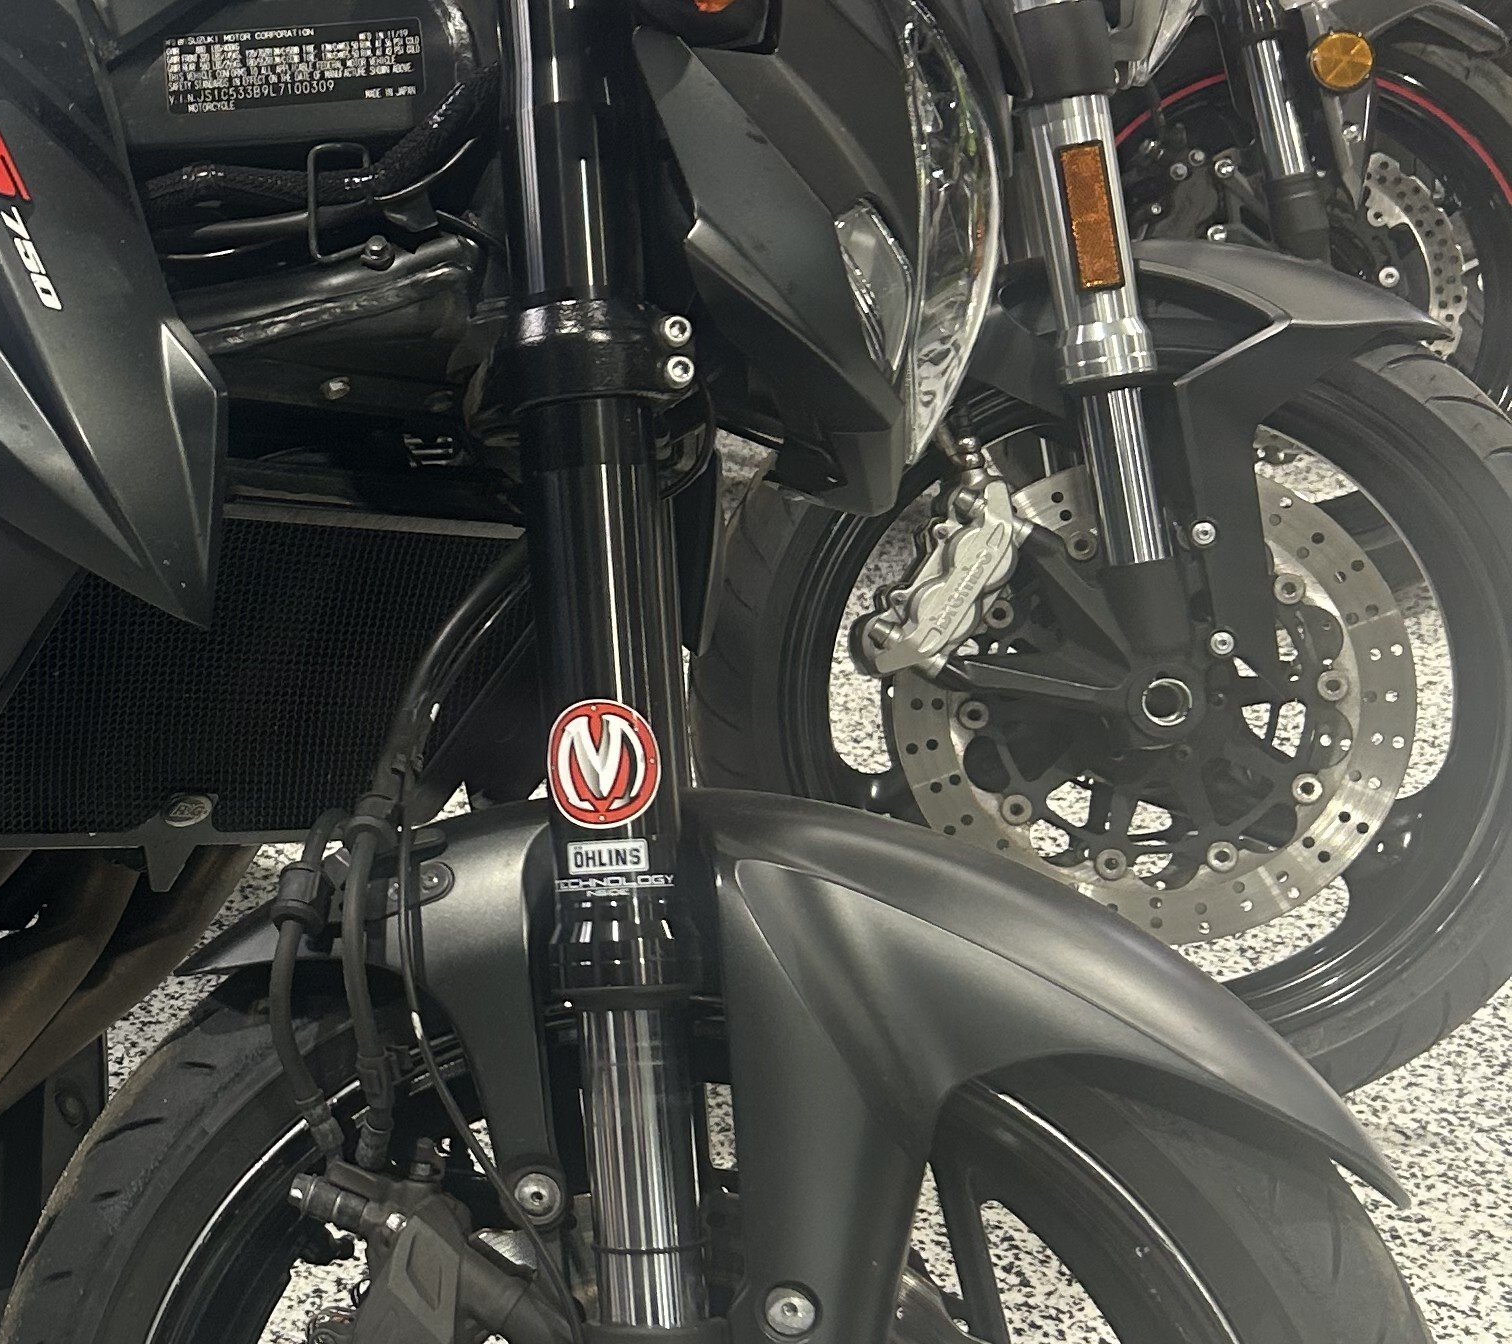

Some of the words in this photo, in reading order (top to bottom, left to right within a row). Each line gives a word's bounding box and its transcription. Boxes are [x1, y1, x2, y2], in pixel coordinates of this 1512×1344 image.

[188, 35, 219, 45] SUZUKI
[223, 32, 252, 43] MOTOR
[254, 28, 315, 41] CORPORATION
[187, 100, 236, 113] MOTORCYCLE
[0, 206, 62, 311] 750
